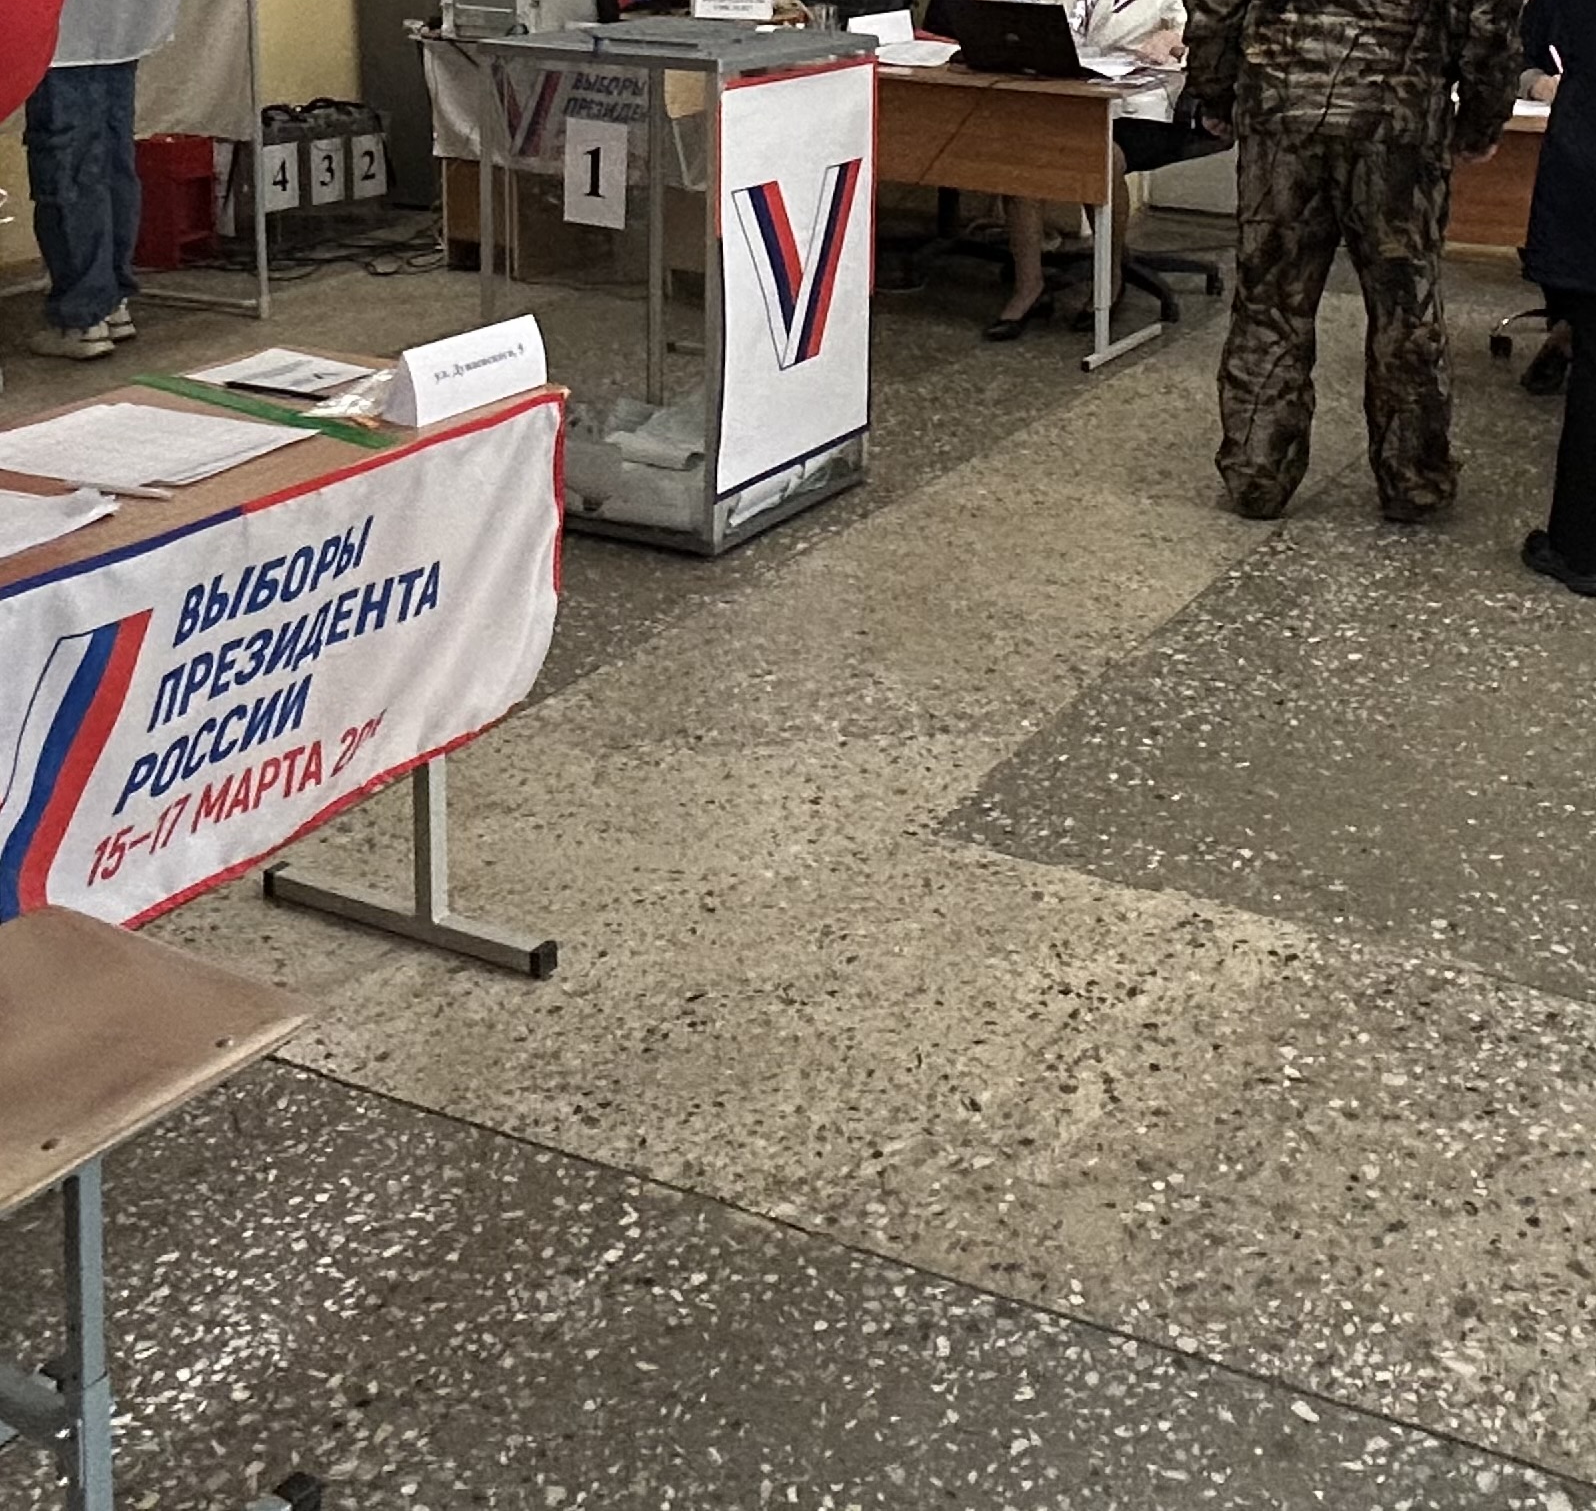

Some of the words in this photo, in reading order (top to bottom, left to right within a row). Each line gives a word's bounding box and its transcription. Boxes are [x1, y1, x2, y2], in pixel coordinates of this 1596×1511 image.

[272, 157, 289, 191] 4
[320, 154, 335, 186] 3
[361, 150, 376, 181] 2
[583, 146, 606, 199] 1
[173, 515, 374, 648] ВЫБОРЫ
[147, 560, 441, 734] ПРЕЗИДЕНТА
[112, 674, 314, 816] РОССИИ
[191, 740, 323, 835] МАРТА
